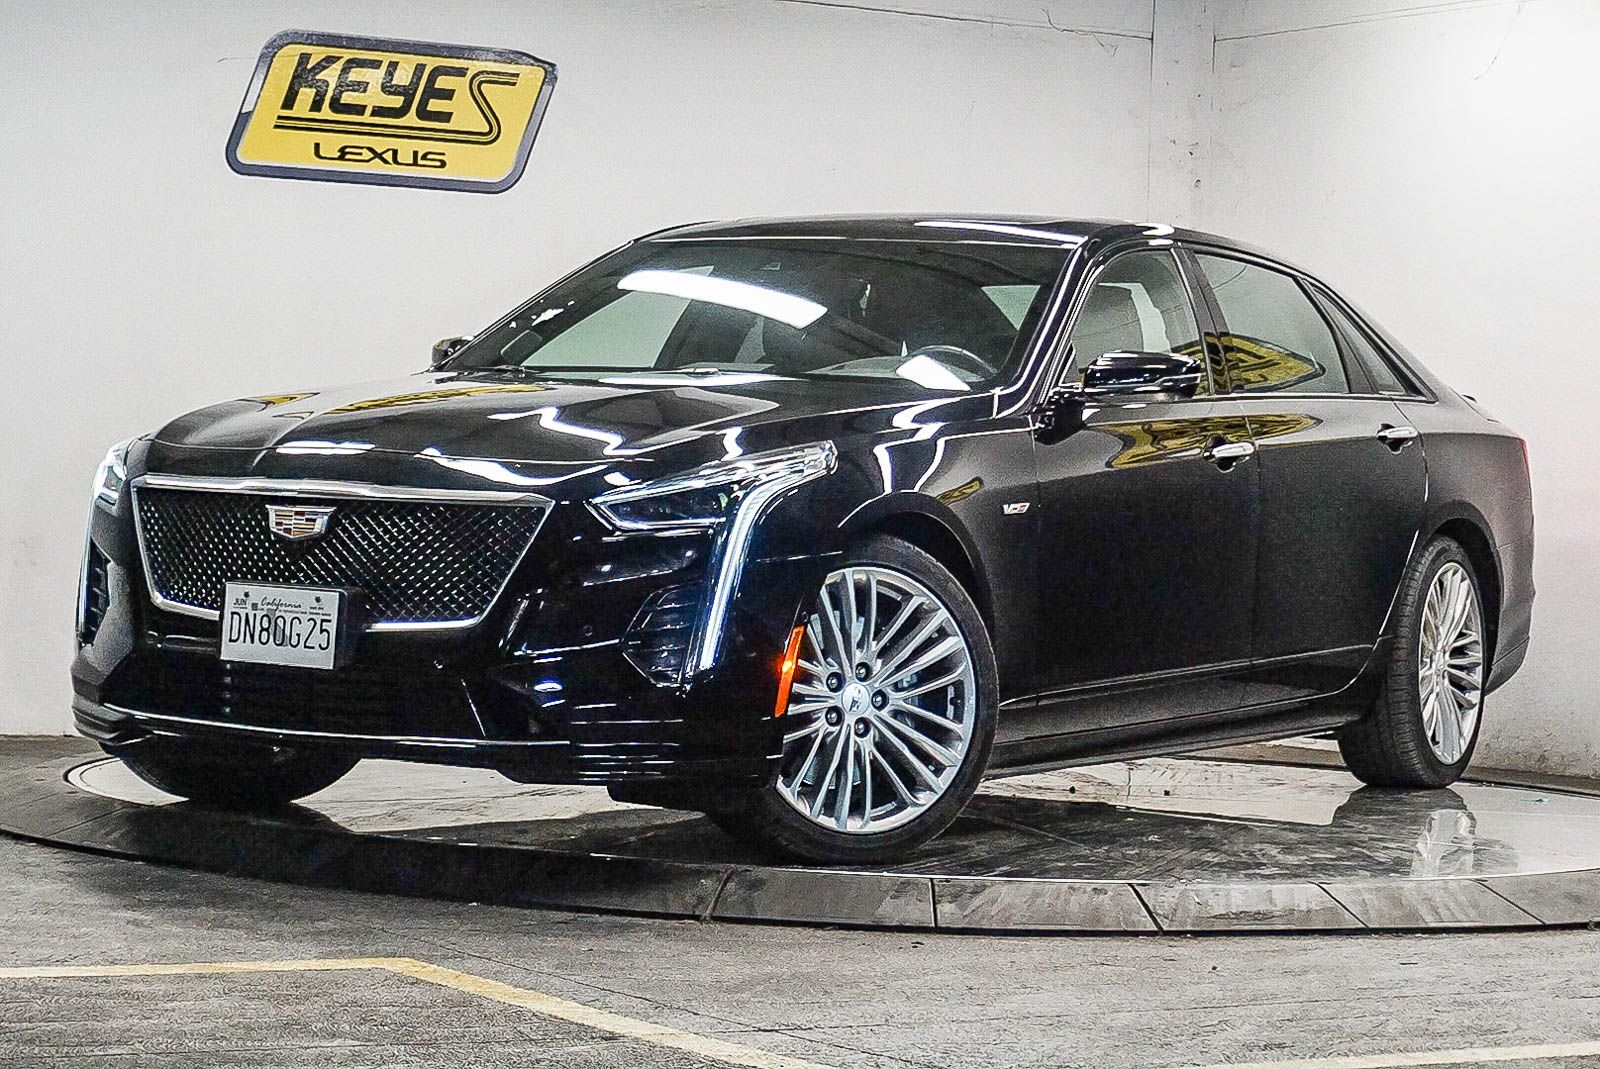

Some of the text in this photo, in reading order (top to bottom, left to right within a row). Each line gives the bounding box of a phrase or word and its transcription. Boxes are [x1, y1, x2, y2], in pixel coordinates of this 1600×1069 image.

[274, 53, 520, 145] KEYES
[313, 142, 447, 169] LEXUS
[261, 596, 302, 612] California
[229, 612, 332, 651] DN80G25
